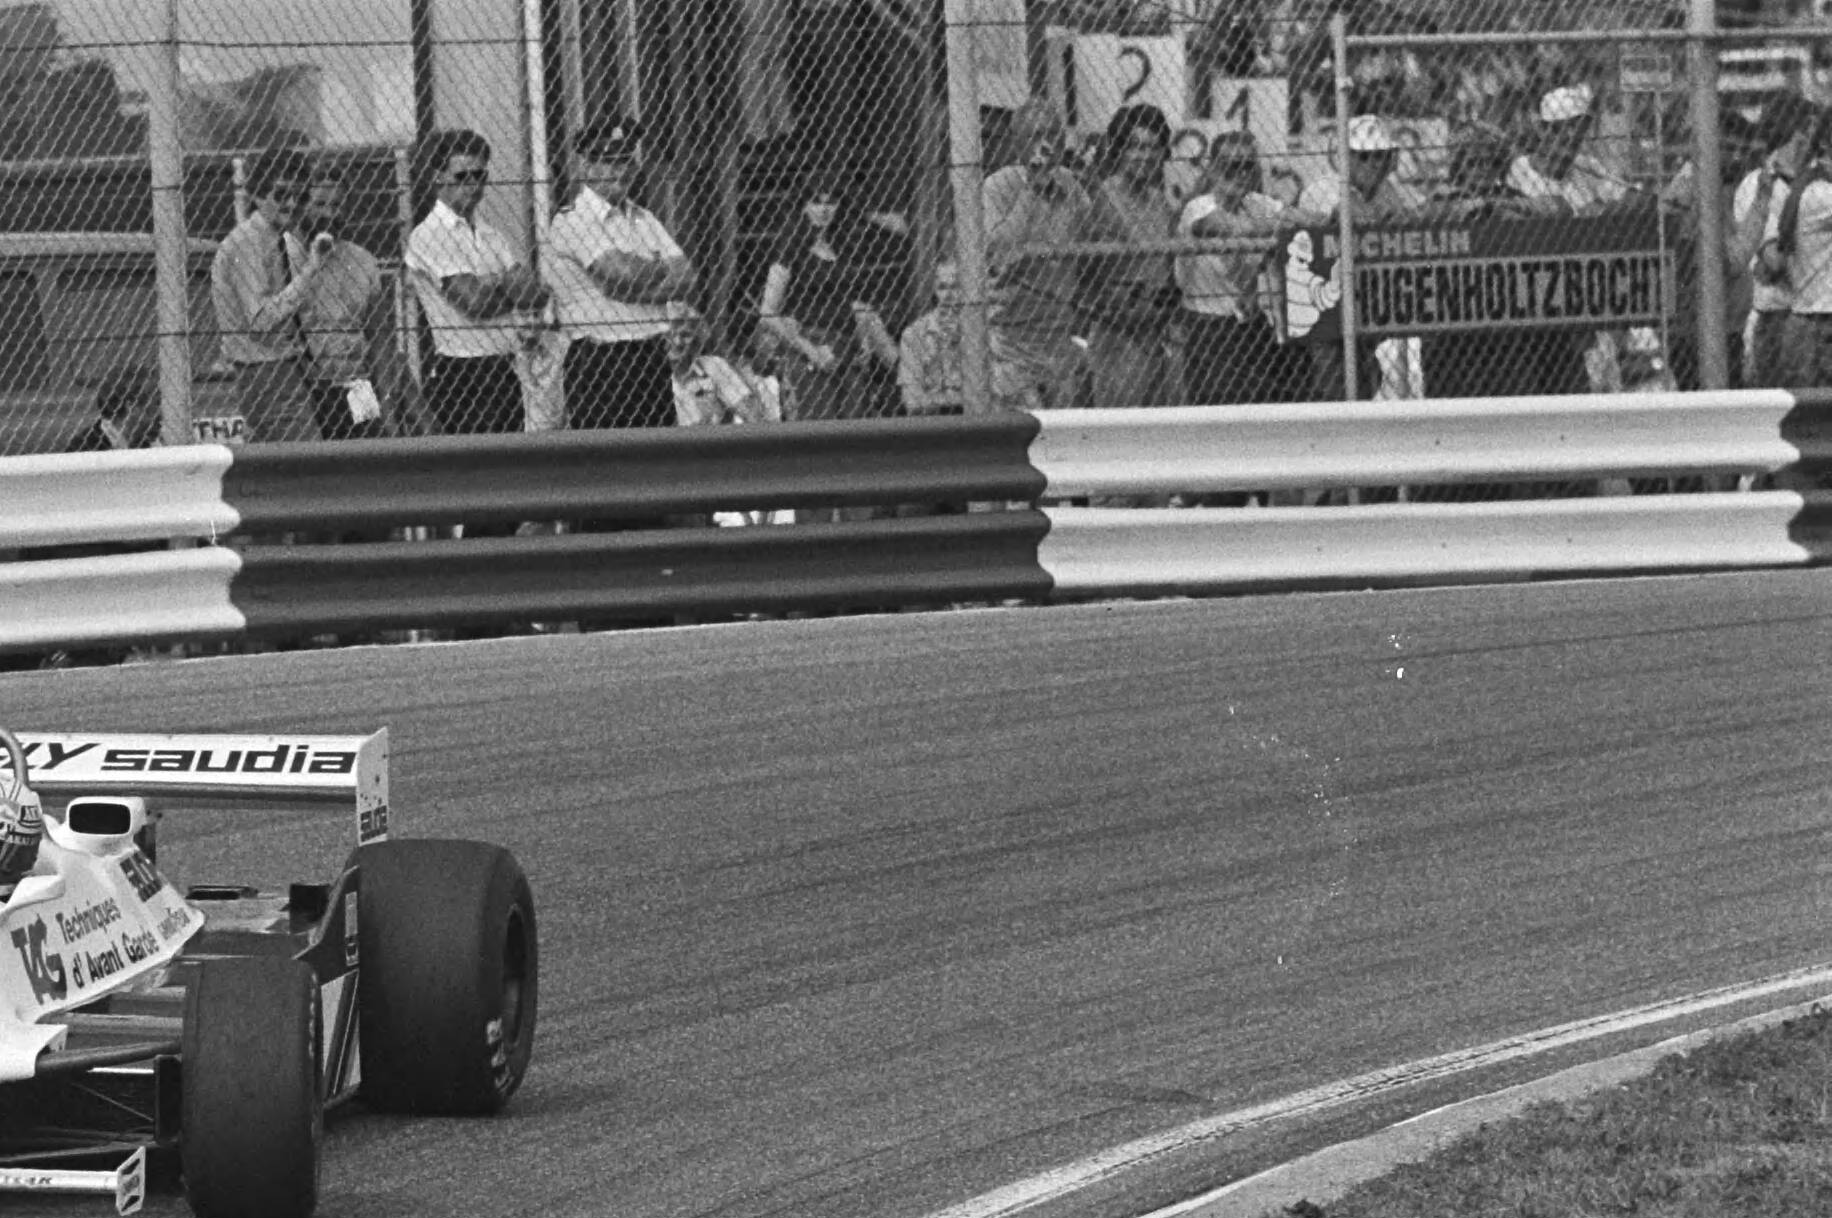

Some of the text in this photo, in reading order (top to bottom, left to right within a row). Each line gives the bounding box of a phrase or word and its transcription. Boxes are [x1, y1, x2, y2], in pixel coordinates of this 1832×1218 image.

[100, 744, 358, 774] saudia
[55, 896, 122, 945] Techniques
[10, 913, 68, 1006] TAG
[85, 940, 125, 984] Avant
[121, 925, 160, 964] Garde
